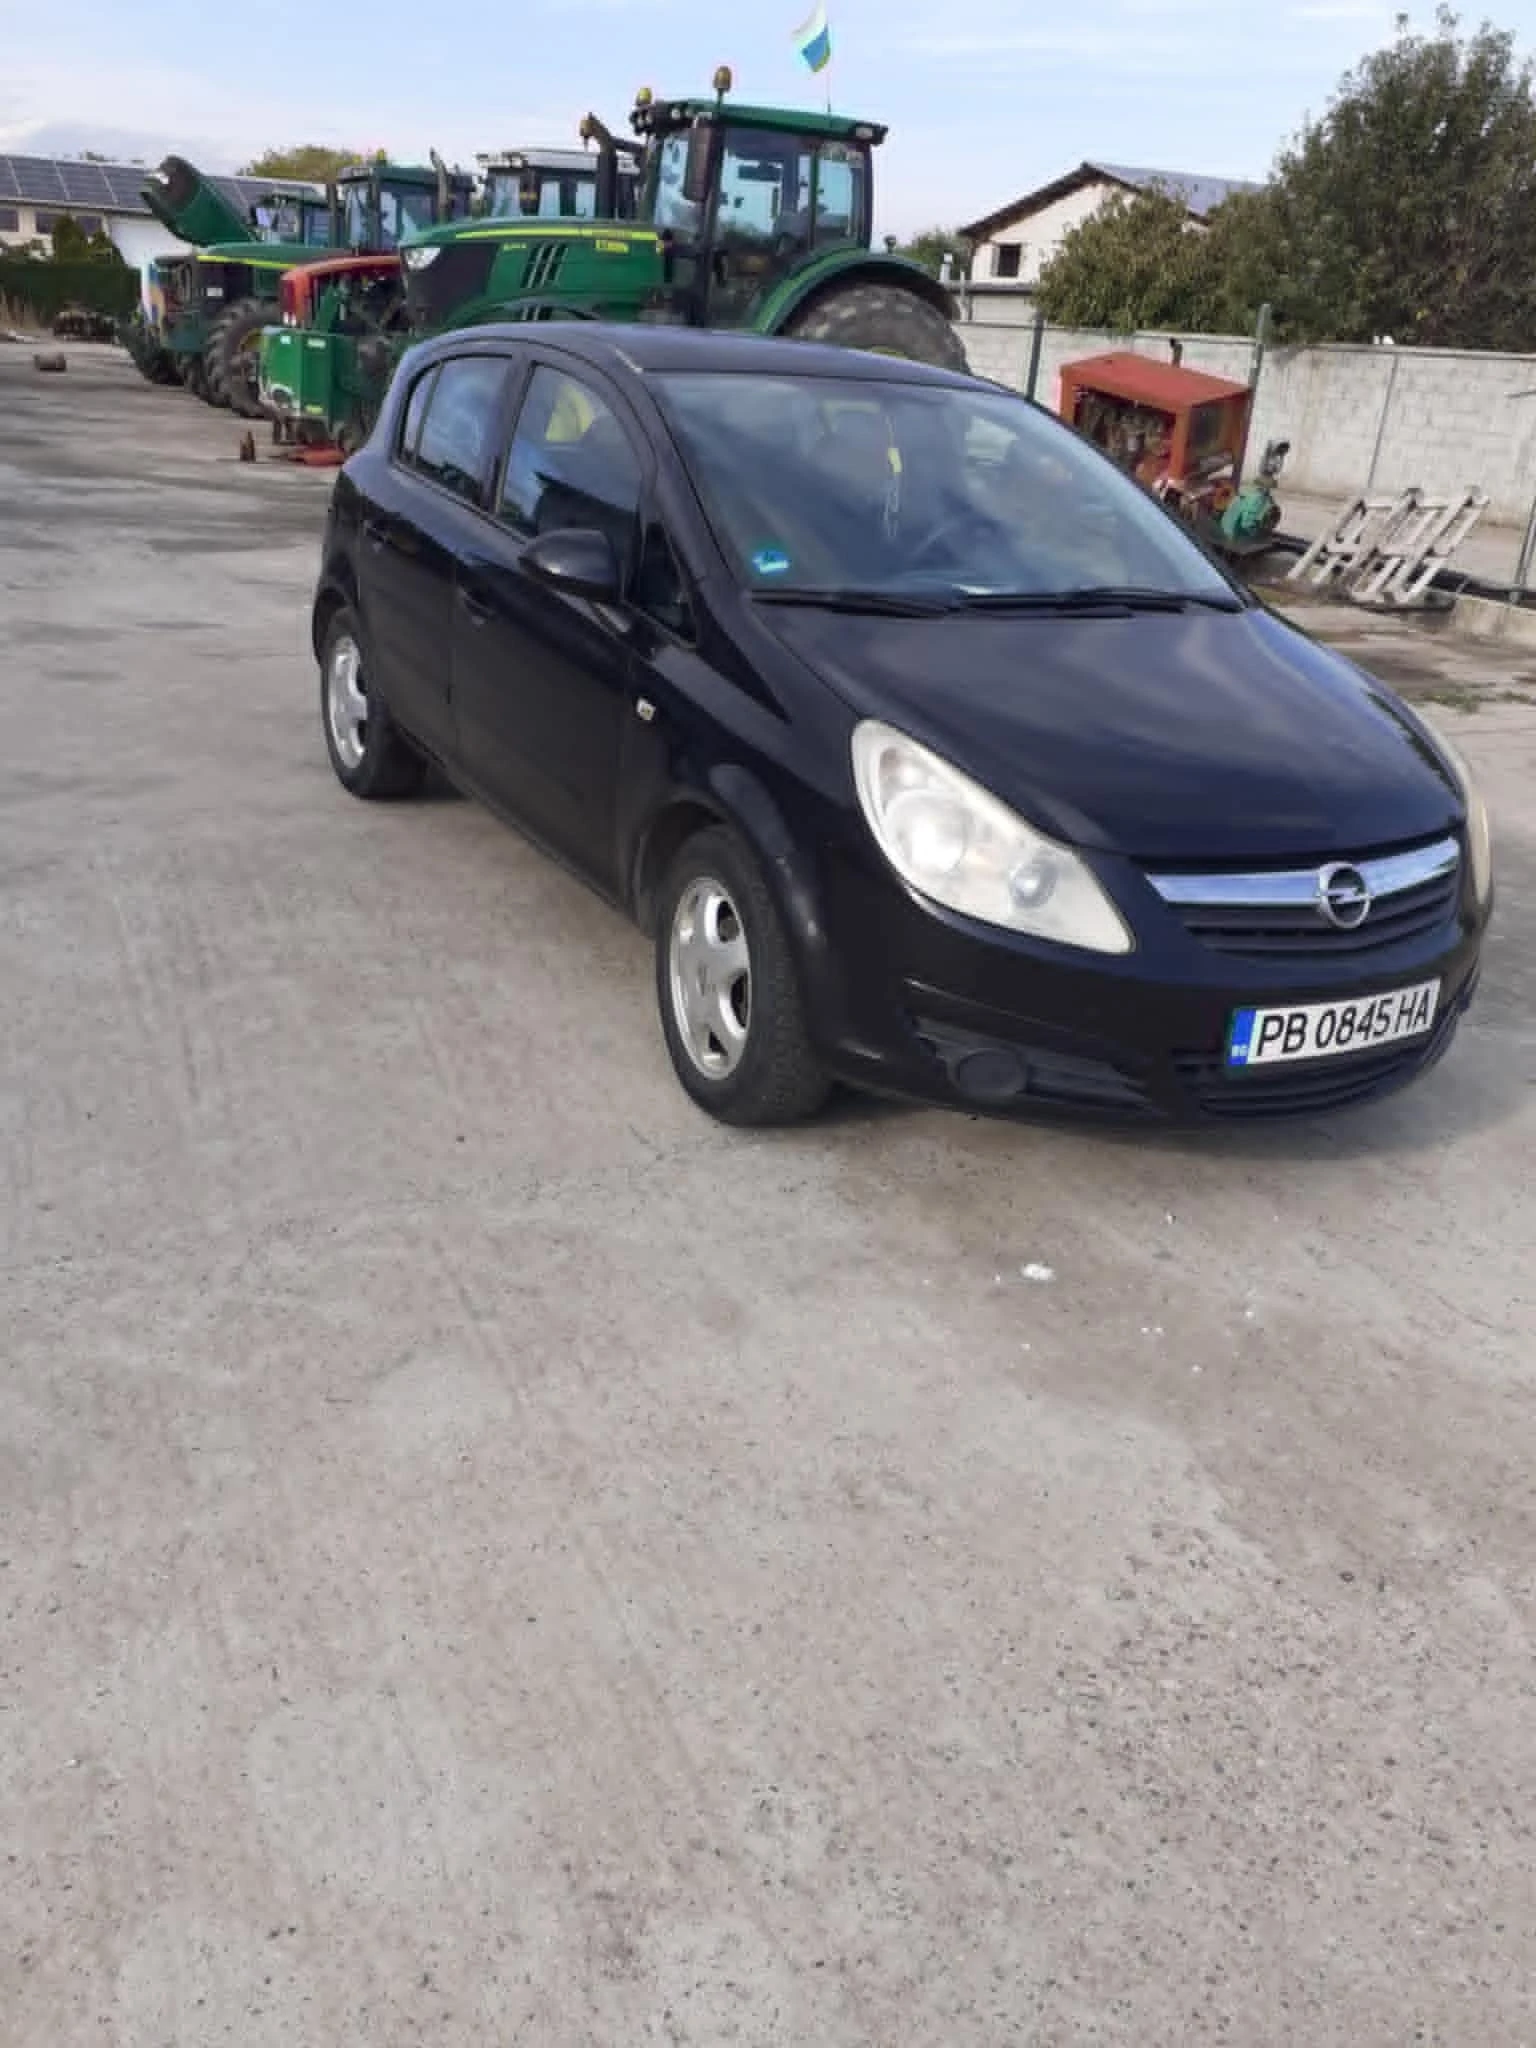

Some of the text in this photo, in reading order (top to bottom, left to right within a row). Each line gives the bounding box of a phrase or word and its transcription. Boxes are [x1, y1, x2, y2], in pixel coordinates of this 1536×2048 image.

[1256, 989, 1430, 1056] PB 0845 HA
